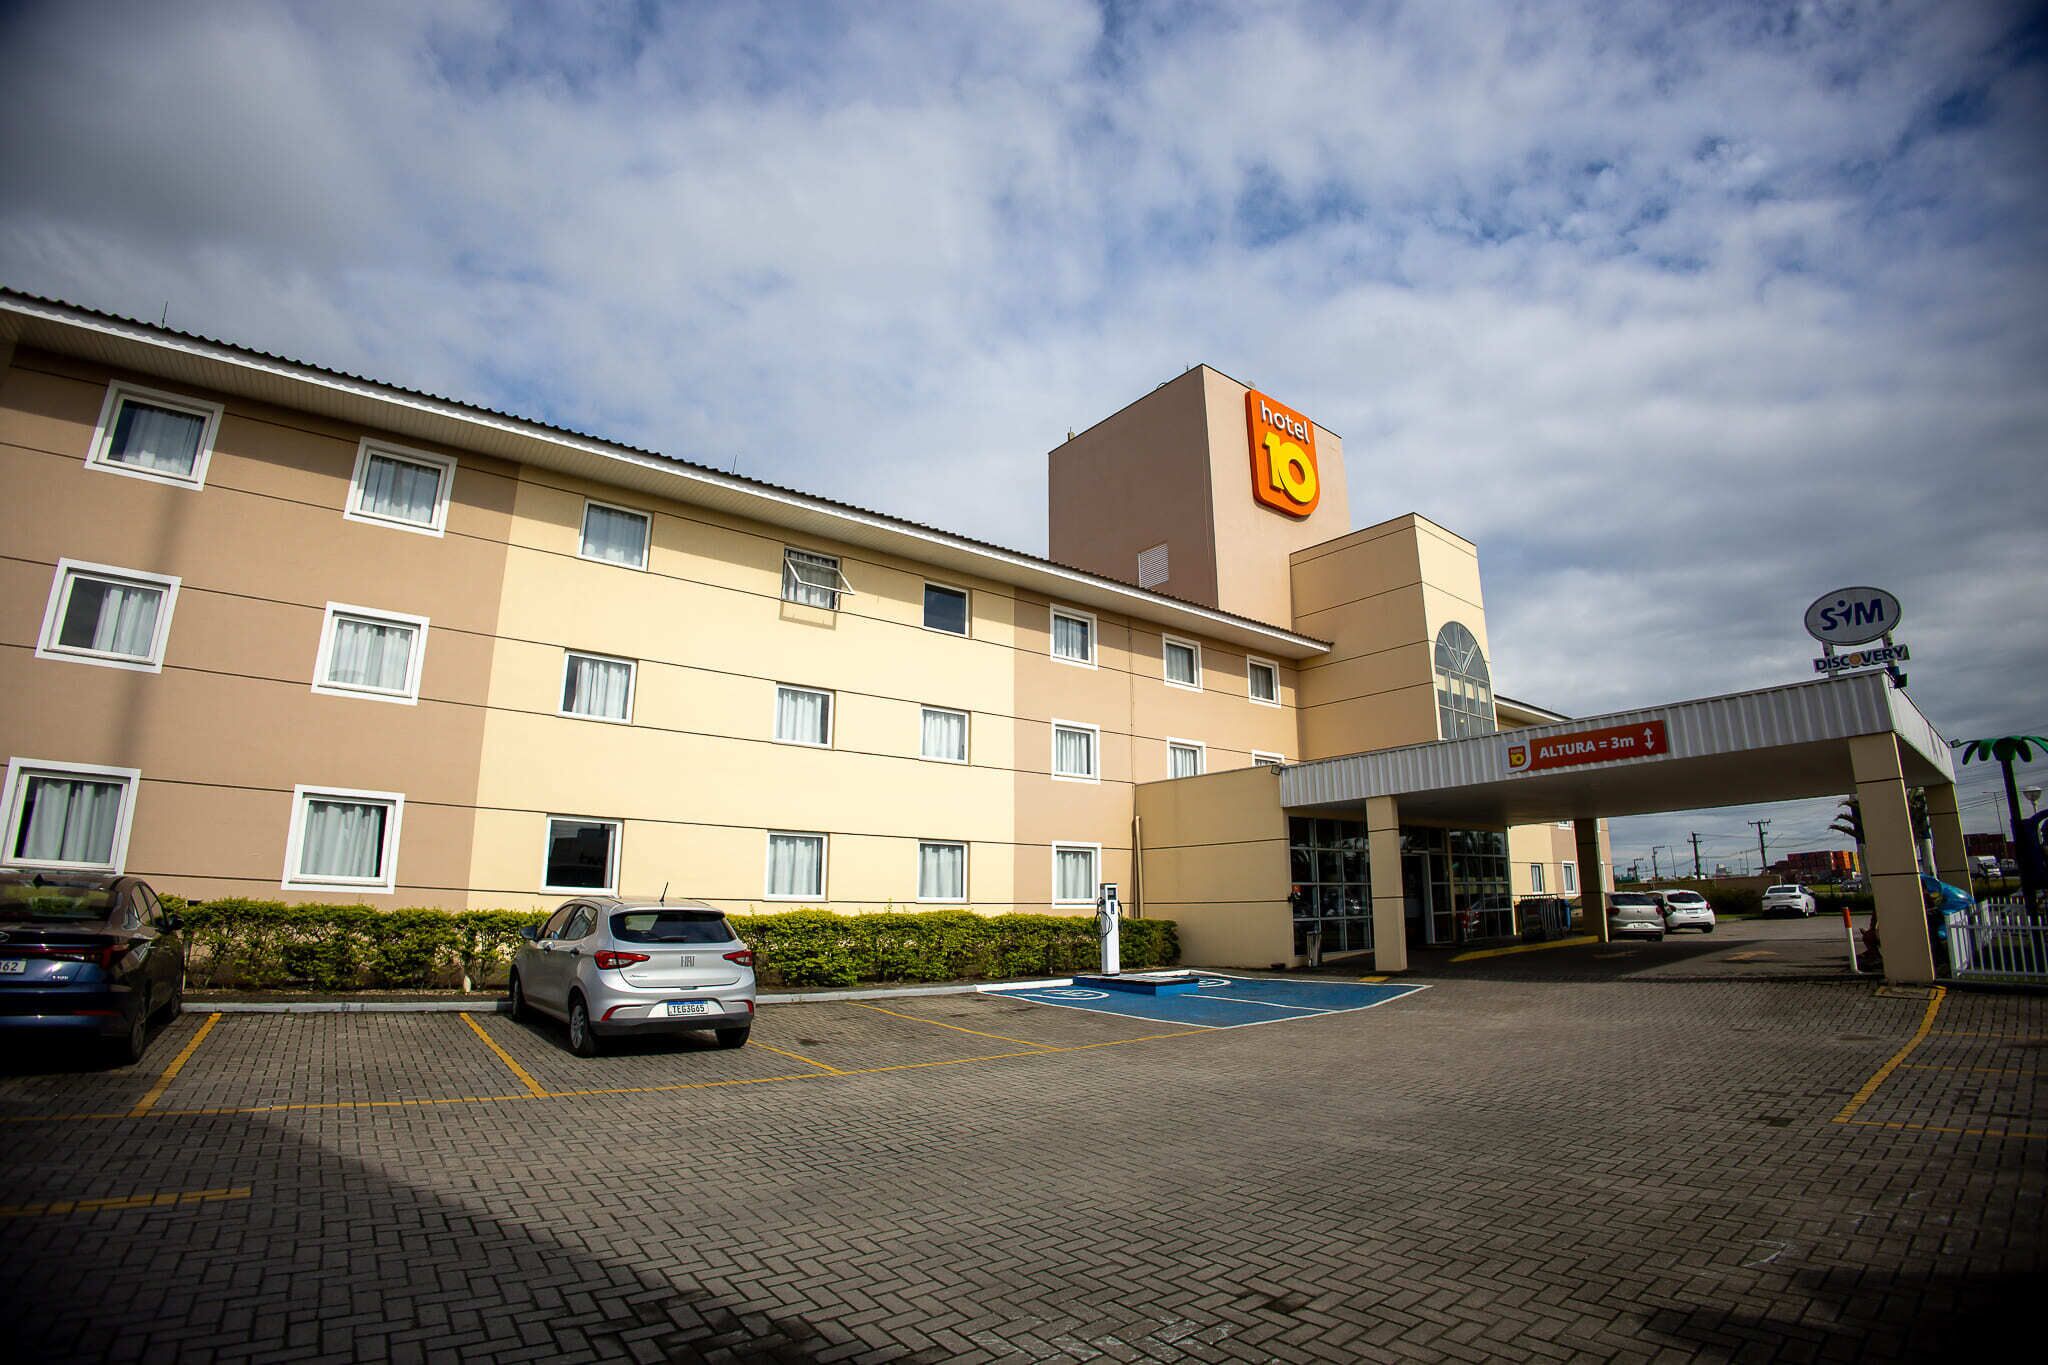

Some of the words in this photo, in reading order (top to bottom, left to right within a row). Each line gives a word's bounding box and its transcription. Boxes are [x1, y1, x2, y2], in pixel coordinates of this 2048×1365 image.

[1260, 399, 1310, 444] hotel
[1264, 431, 1317, 503] 10
[1815, 645, 1905, 671] DISCOVERY
[1539, 742, 1596, 759] ALTURA
[1611, 736, 1635, 749] 3m
[680, 955, 696, 968] FIAT
